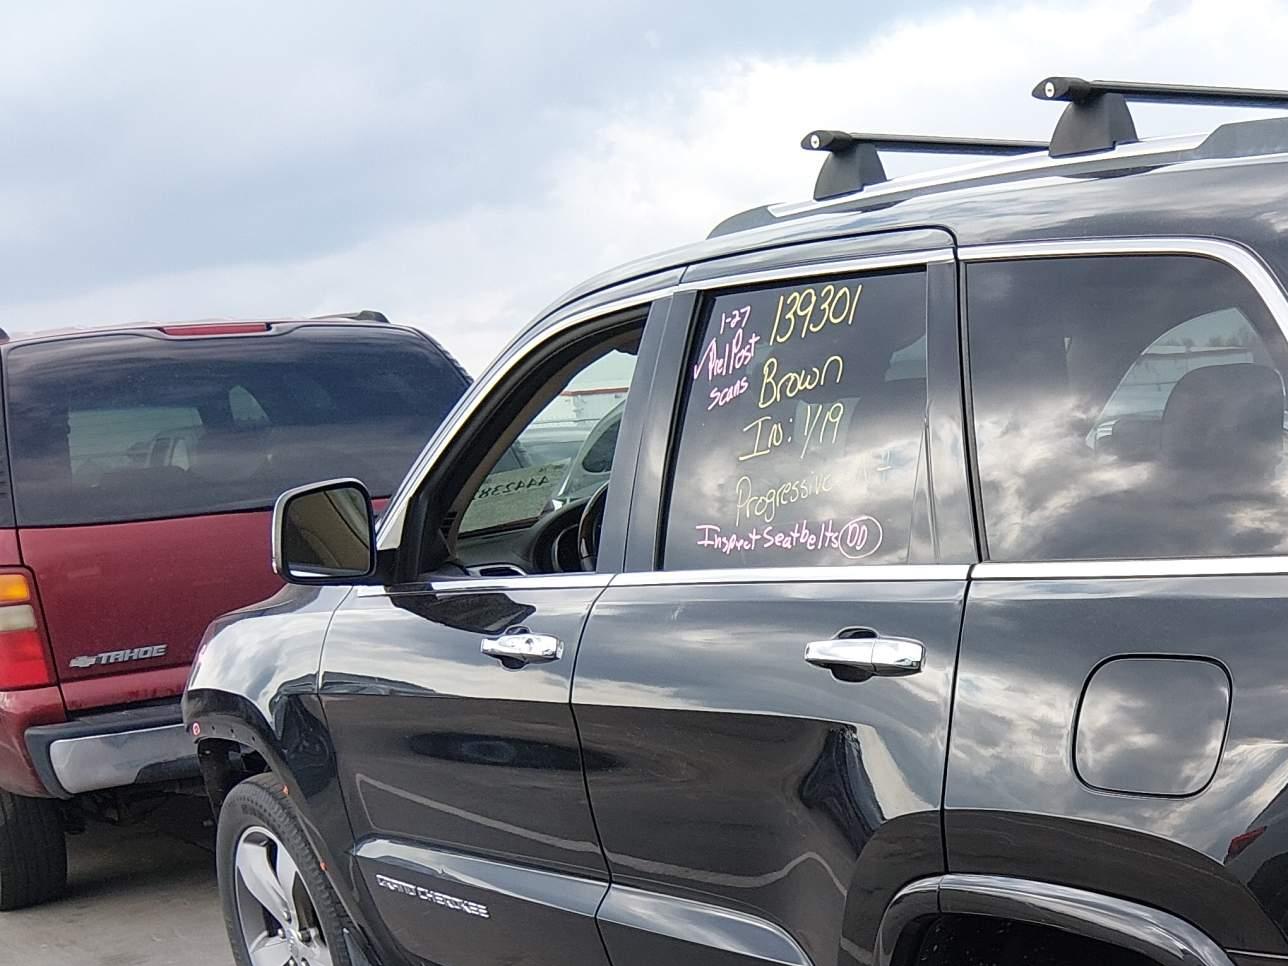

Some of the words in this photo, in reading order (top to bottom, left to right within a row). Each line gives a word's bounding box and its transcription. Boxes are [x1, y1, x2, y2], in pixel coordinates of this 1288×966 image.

[719, 305, 752, 335] 1-27
[769, 284, 863, 346] 139301
[758, 355, 844, 409] Brown
[97, 644, 168, 665] TAHOE
